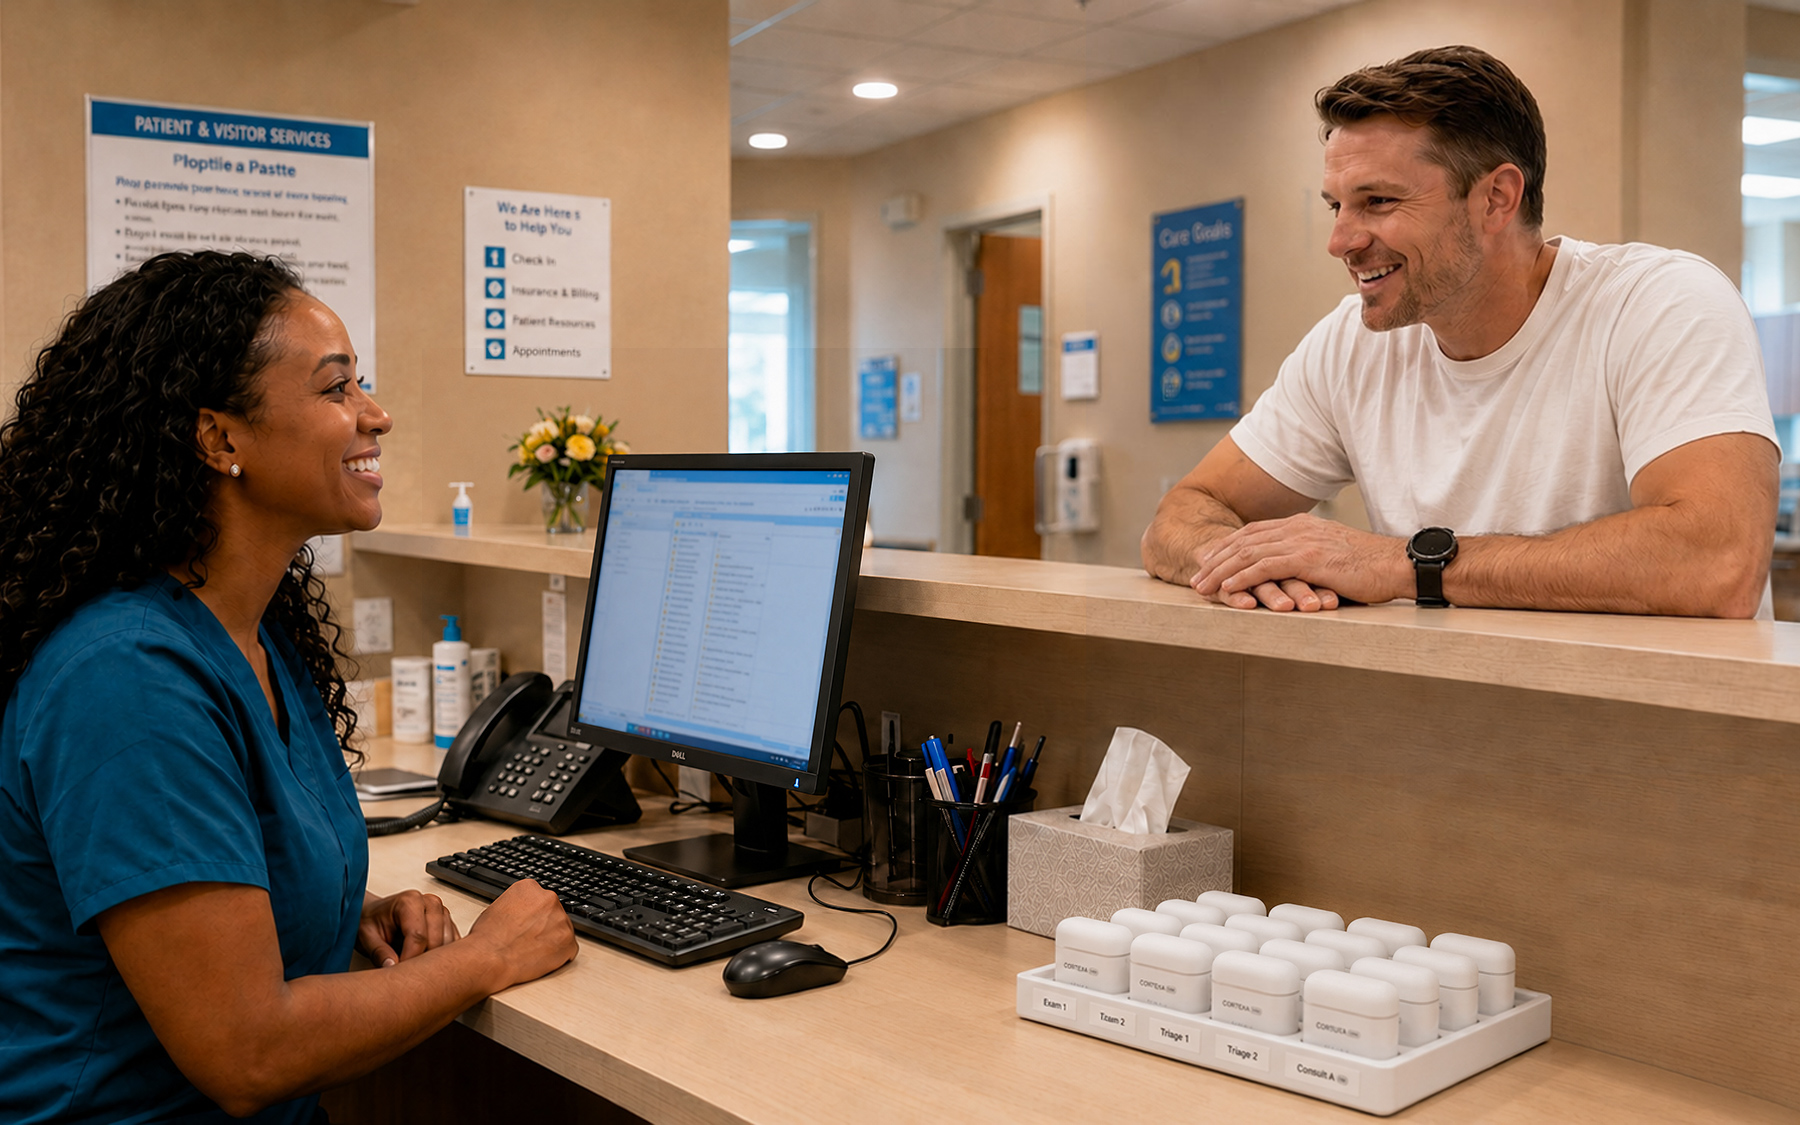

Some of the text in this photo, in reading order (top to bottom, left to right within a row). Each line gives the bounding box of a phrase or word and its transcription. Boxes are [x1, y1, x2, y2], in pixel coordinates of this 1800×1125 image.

[135, 115, 332, 149] PATIENT & VISITOR SERVICES
[235, 162, 245, 173] a
[497, 201, 517, 214] We
[520, 204, 540, 217] Are
[545, 206, 571, 220] Here
[505, 220, 572, 236] to Help You
[512, 253, 543, 266] Check
[512, 286, 599, 301] Insurance & Billing
[512, 315, 596, 329] Patient Resources
[512, 346, 581, 359] Appointments
[672, 750, 686, 760] DELL
[1043, 998, 1067, 1011] Exam 1
[1120, 1018, 1125, 1026] 2
[1160, 1027, 1183, 1042] Triage
[1227, 1045, 1258, 1061] Triage 2
[1296, 1063, 1327, 1079] Consult
[1329, 1073, 1335, 1081] A
